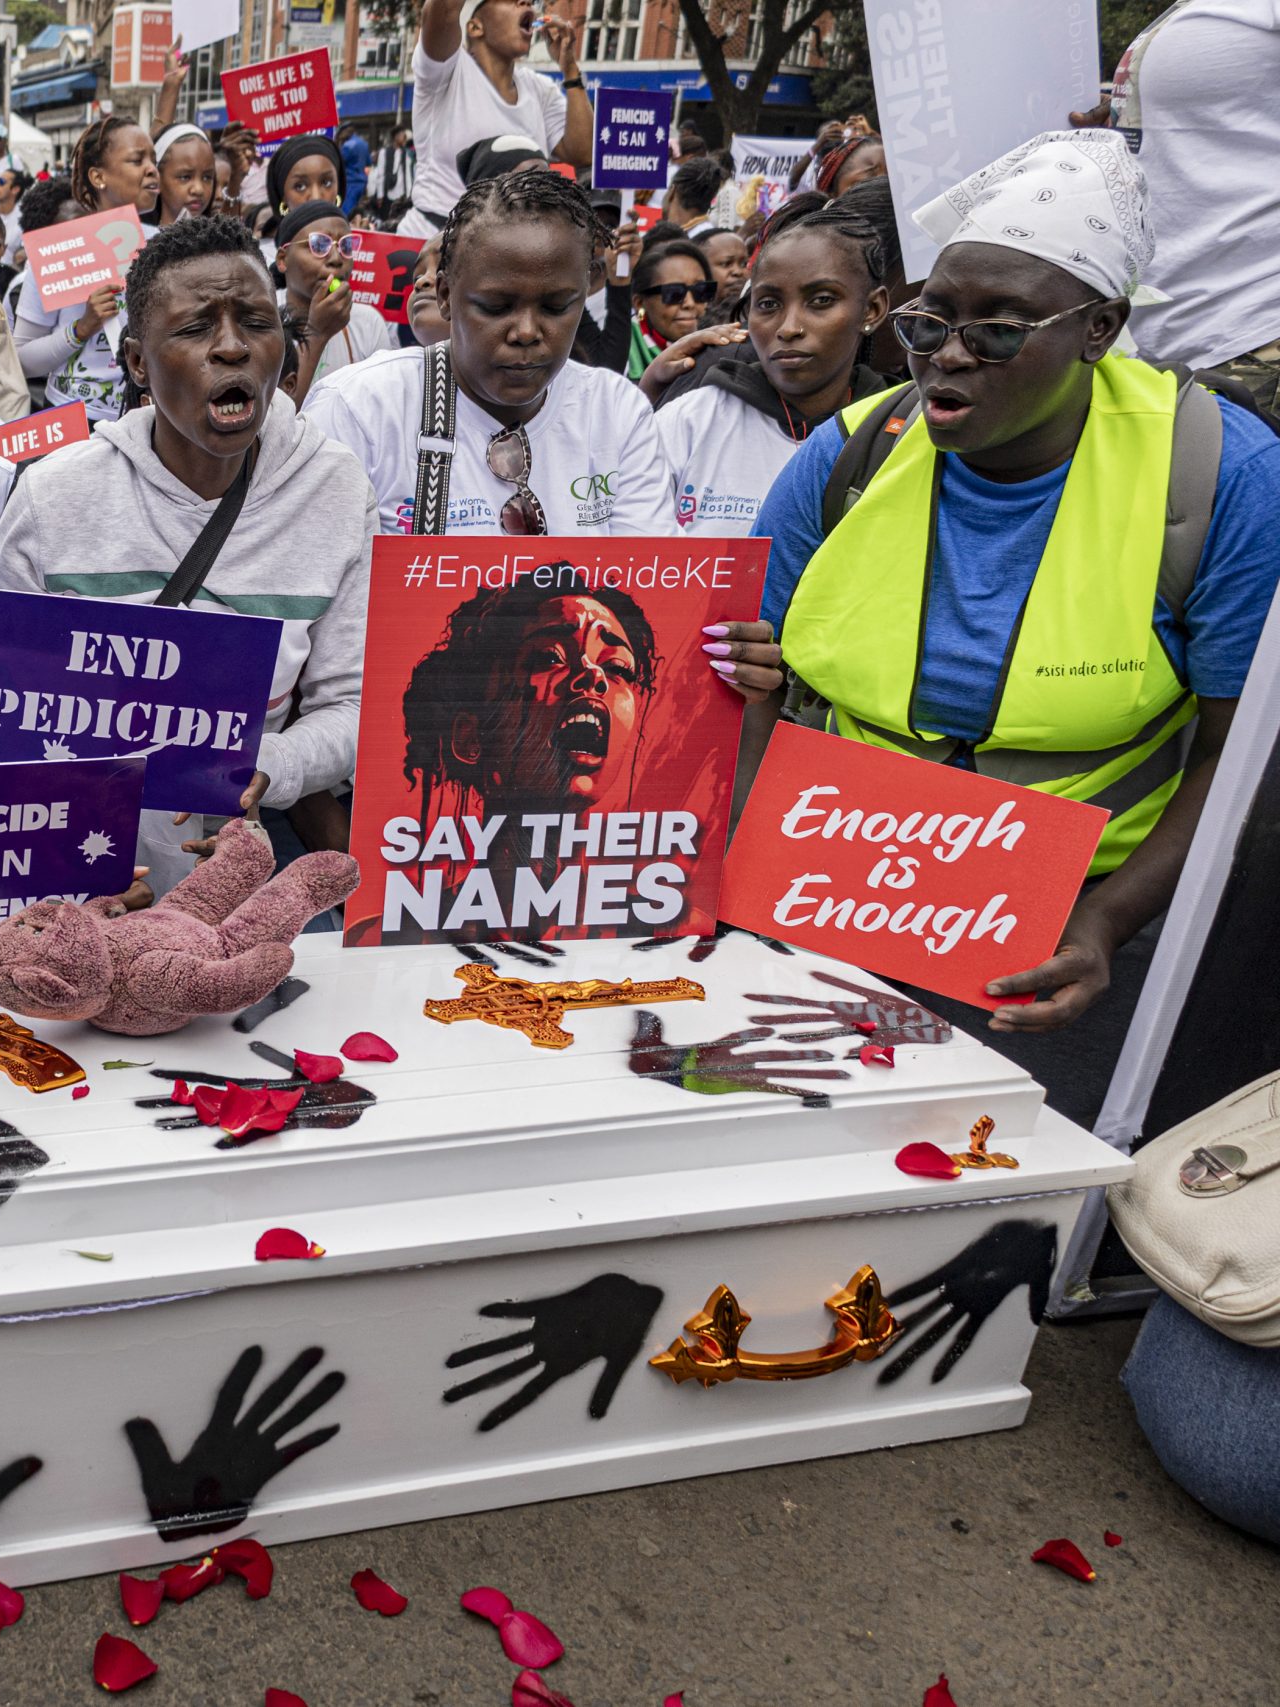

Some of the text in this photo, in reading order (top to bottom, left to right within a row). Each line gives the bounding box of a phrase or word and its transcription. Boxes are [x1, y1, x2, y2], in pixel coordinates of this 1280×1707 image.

[239, 61, 314, 95] ONE LIFE IS
[251, 86, 308, 114] ONE TOO
[264, 109, 302, 134] MANY
[611, 108, 655, 126] FEMICIDE
[618, 132, 646, 147] IS AN
[602, 154, 660, 172] EMERGENCY
[741, 156, 800, 176] HOW MAN
[38, 237, 86, 256] WHERE
[352, 250, 376, 263] ERE
[40, 252, 96, 276] ARE THE
[41, 268, 112, 296] CHILDREN
[2, 429, 40, 458] LIFE
[46, 422, 64, 444] IS
[699, 502, 760, 514] Hospital
[403, 554, 736, 589] #EndFemicideKE
[65, 630, 181, 680] END
[1035, 658, 1146, 677] #sisi ndio solutio
[380, 810, 699, 864] SAY THEIR
[780, 784, 1026, 863] Enough
[866, 844, 920, 890] is
[382, 862, 686, 932] NAMES
[772, 872, 1018, 955] Enough
